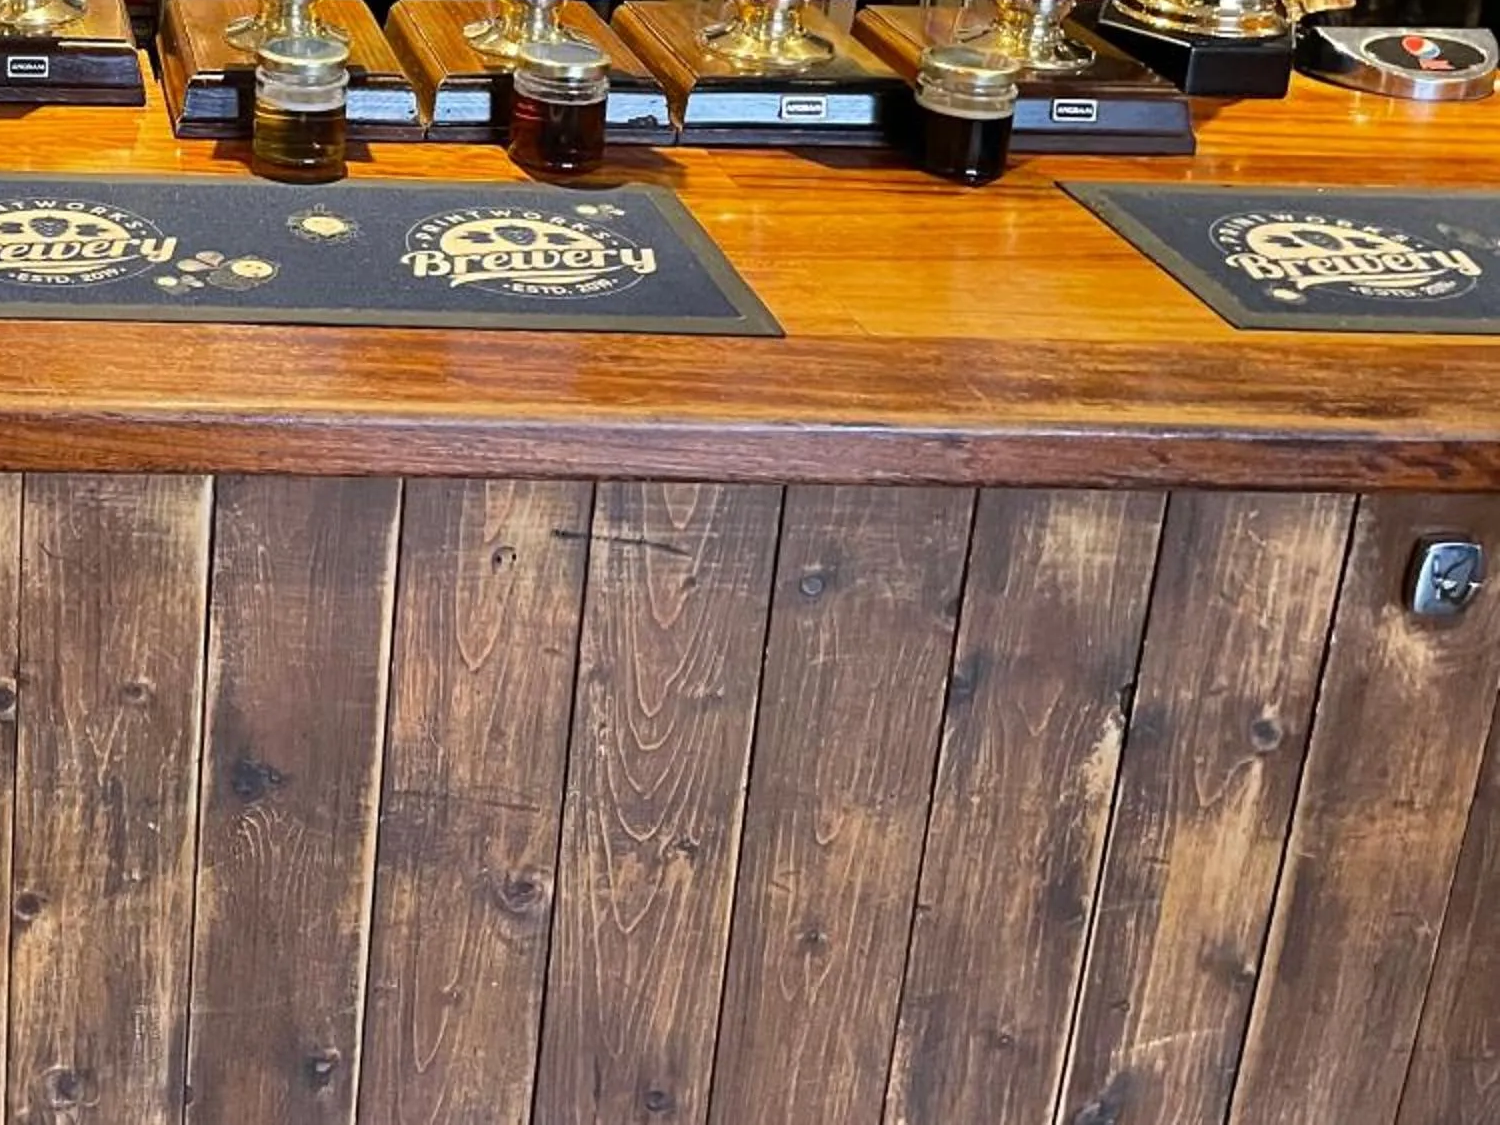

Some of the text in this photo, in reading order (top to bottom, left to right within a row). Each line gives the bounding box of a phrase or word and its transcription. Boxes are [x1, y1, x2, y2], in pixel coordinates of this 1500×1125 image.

[420, 208, 614, 242] PRINTWORKS
[1219, 213, 1408, 244] PRINTWORKS
[401, 246, 657, 279] Brewery
[1226, 249, 1483, 281] Brewery
